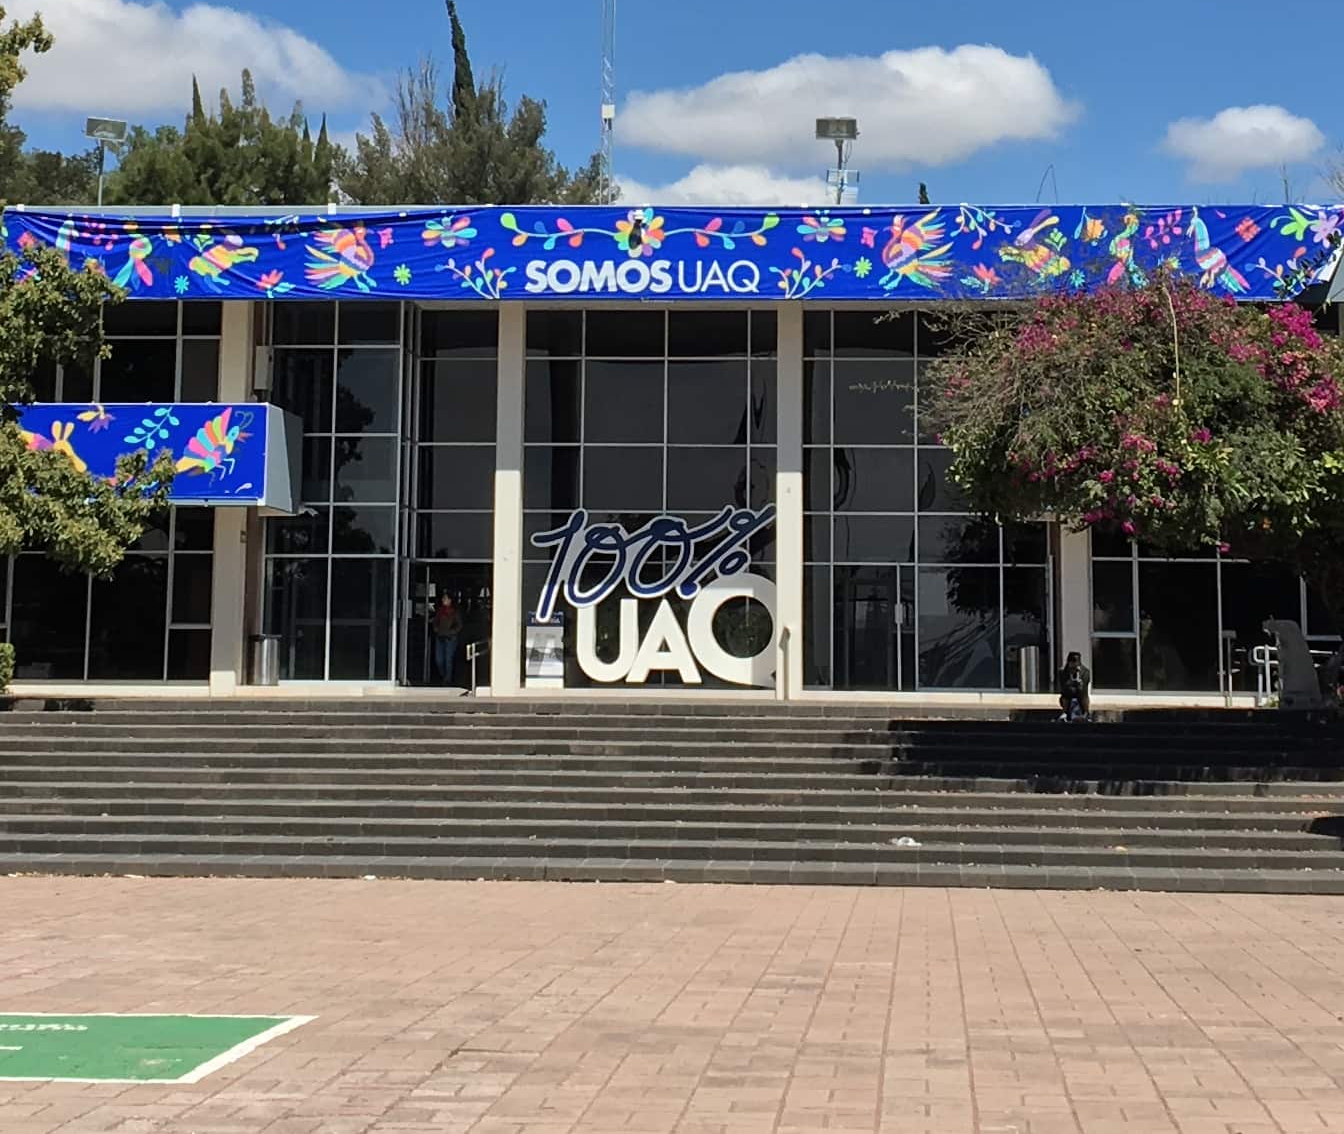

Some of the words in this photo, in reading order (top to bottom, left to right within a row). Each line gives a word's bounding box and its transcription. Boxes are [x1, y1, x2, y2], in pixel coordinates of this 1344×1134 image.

[525, 259, 672, 293] SOMOS
[678, 260, 760, 294] UAQ
[531, 503, 777, 623] 100%
[576, 572, 777, 688] UAQ
